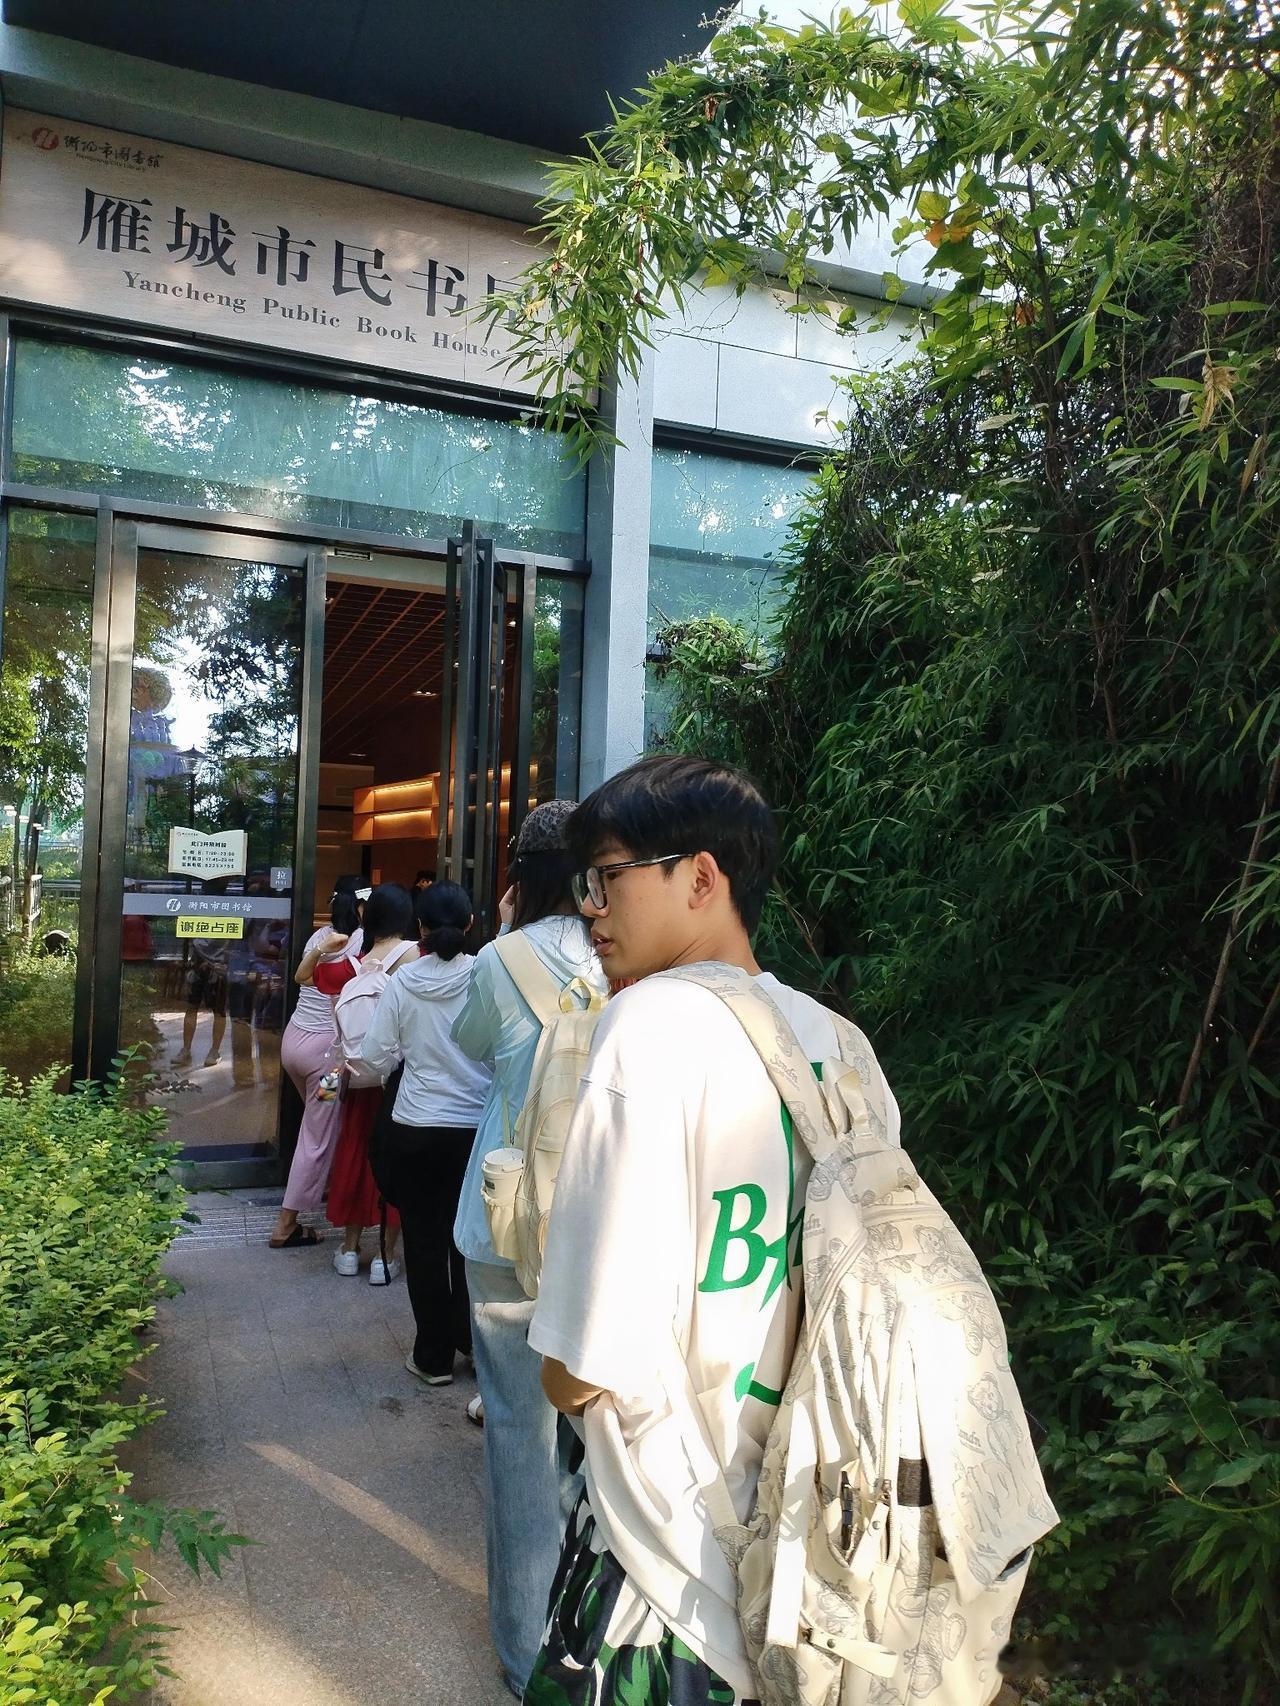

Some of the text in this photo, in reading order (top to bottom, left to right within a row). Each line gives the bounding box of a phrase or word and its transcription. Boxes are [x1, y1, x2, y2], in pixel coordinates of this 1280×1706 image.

[122, 270, 501, 360] Yancheng Public Book House
[180, 921, 240, 934] 谢绝占座
